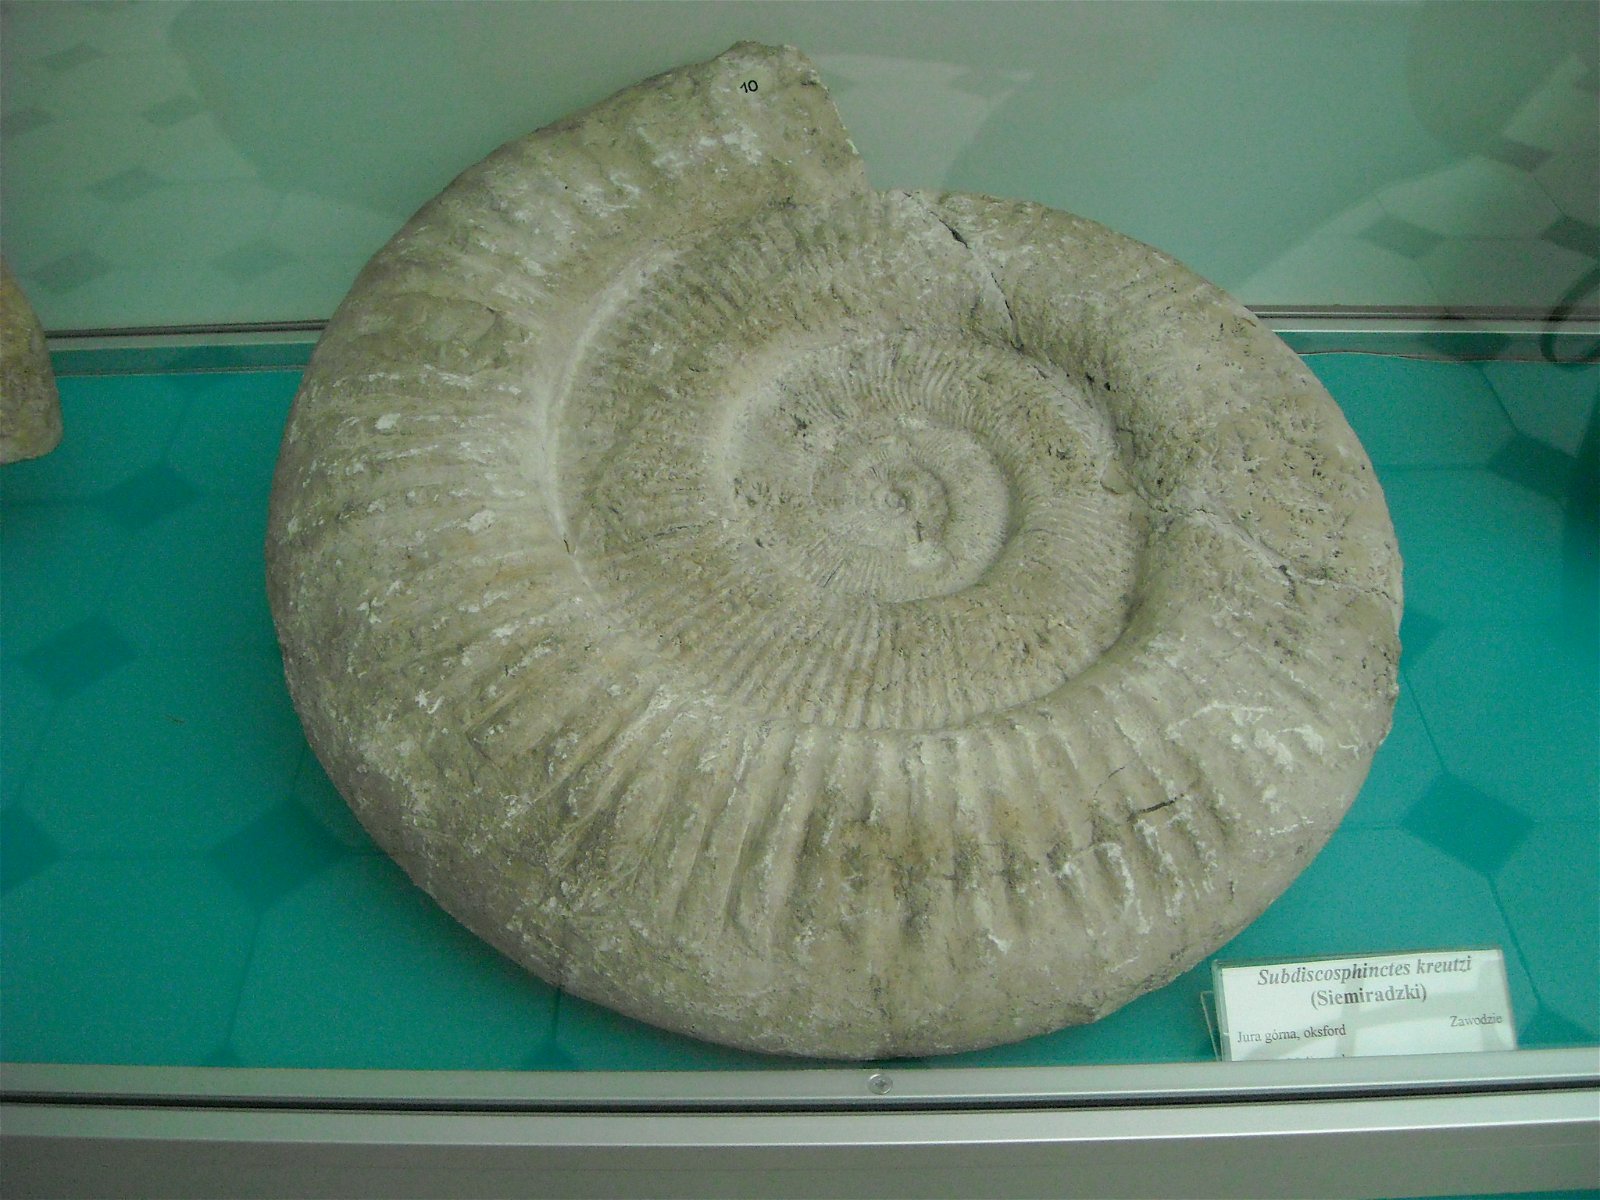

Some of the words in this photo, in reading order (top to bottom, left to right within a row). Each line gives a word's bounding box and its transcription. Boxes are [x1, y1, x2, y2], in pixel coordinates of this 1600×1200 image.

[740, 80, 758, 93] 10
[1257, 960, 1411, 986] Subdiscosphinctes
[1416, 955, 1473, 975] kreutzi
[1310, 983, 1427, 1010] (Siemiradzki)
[1450, 1013, 1503, 1027] Zawodzie
[1237, 1031, 1262, 1043] Jura
[1265, 1028, 1300, 1044] górna,
[1303, 1024, 1347, 1039] oksford
